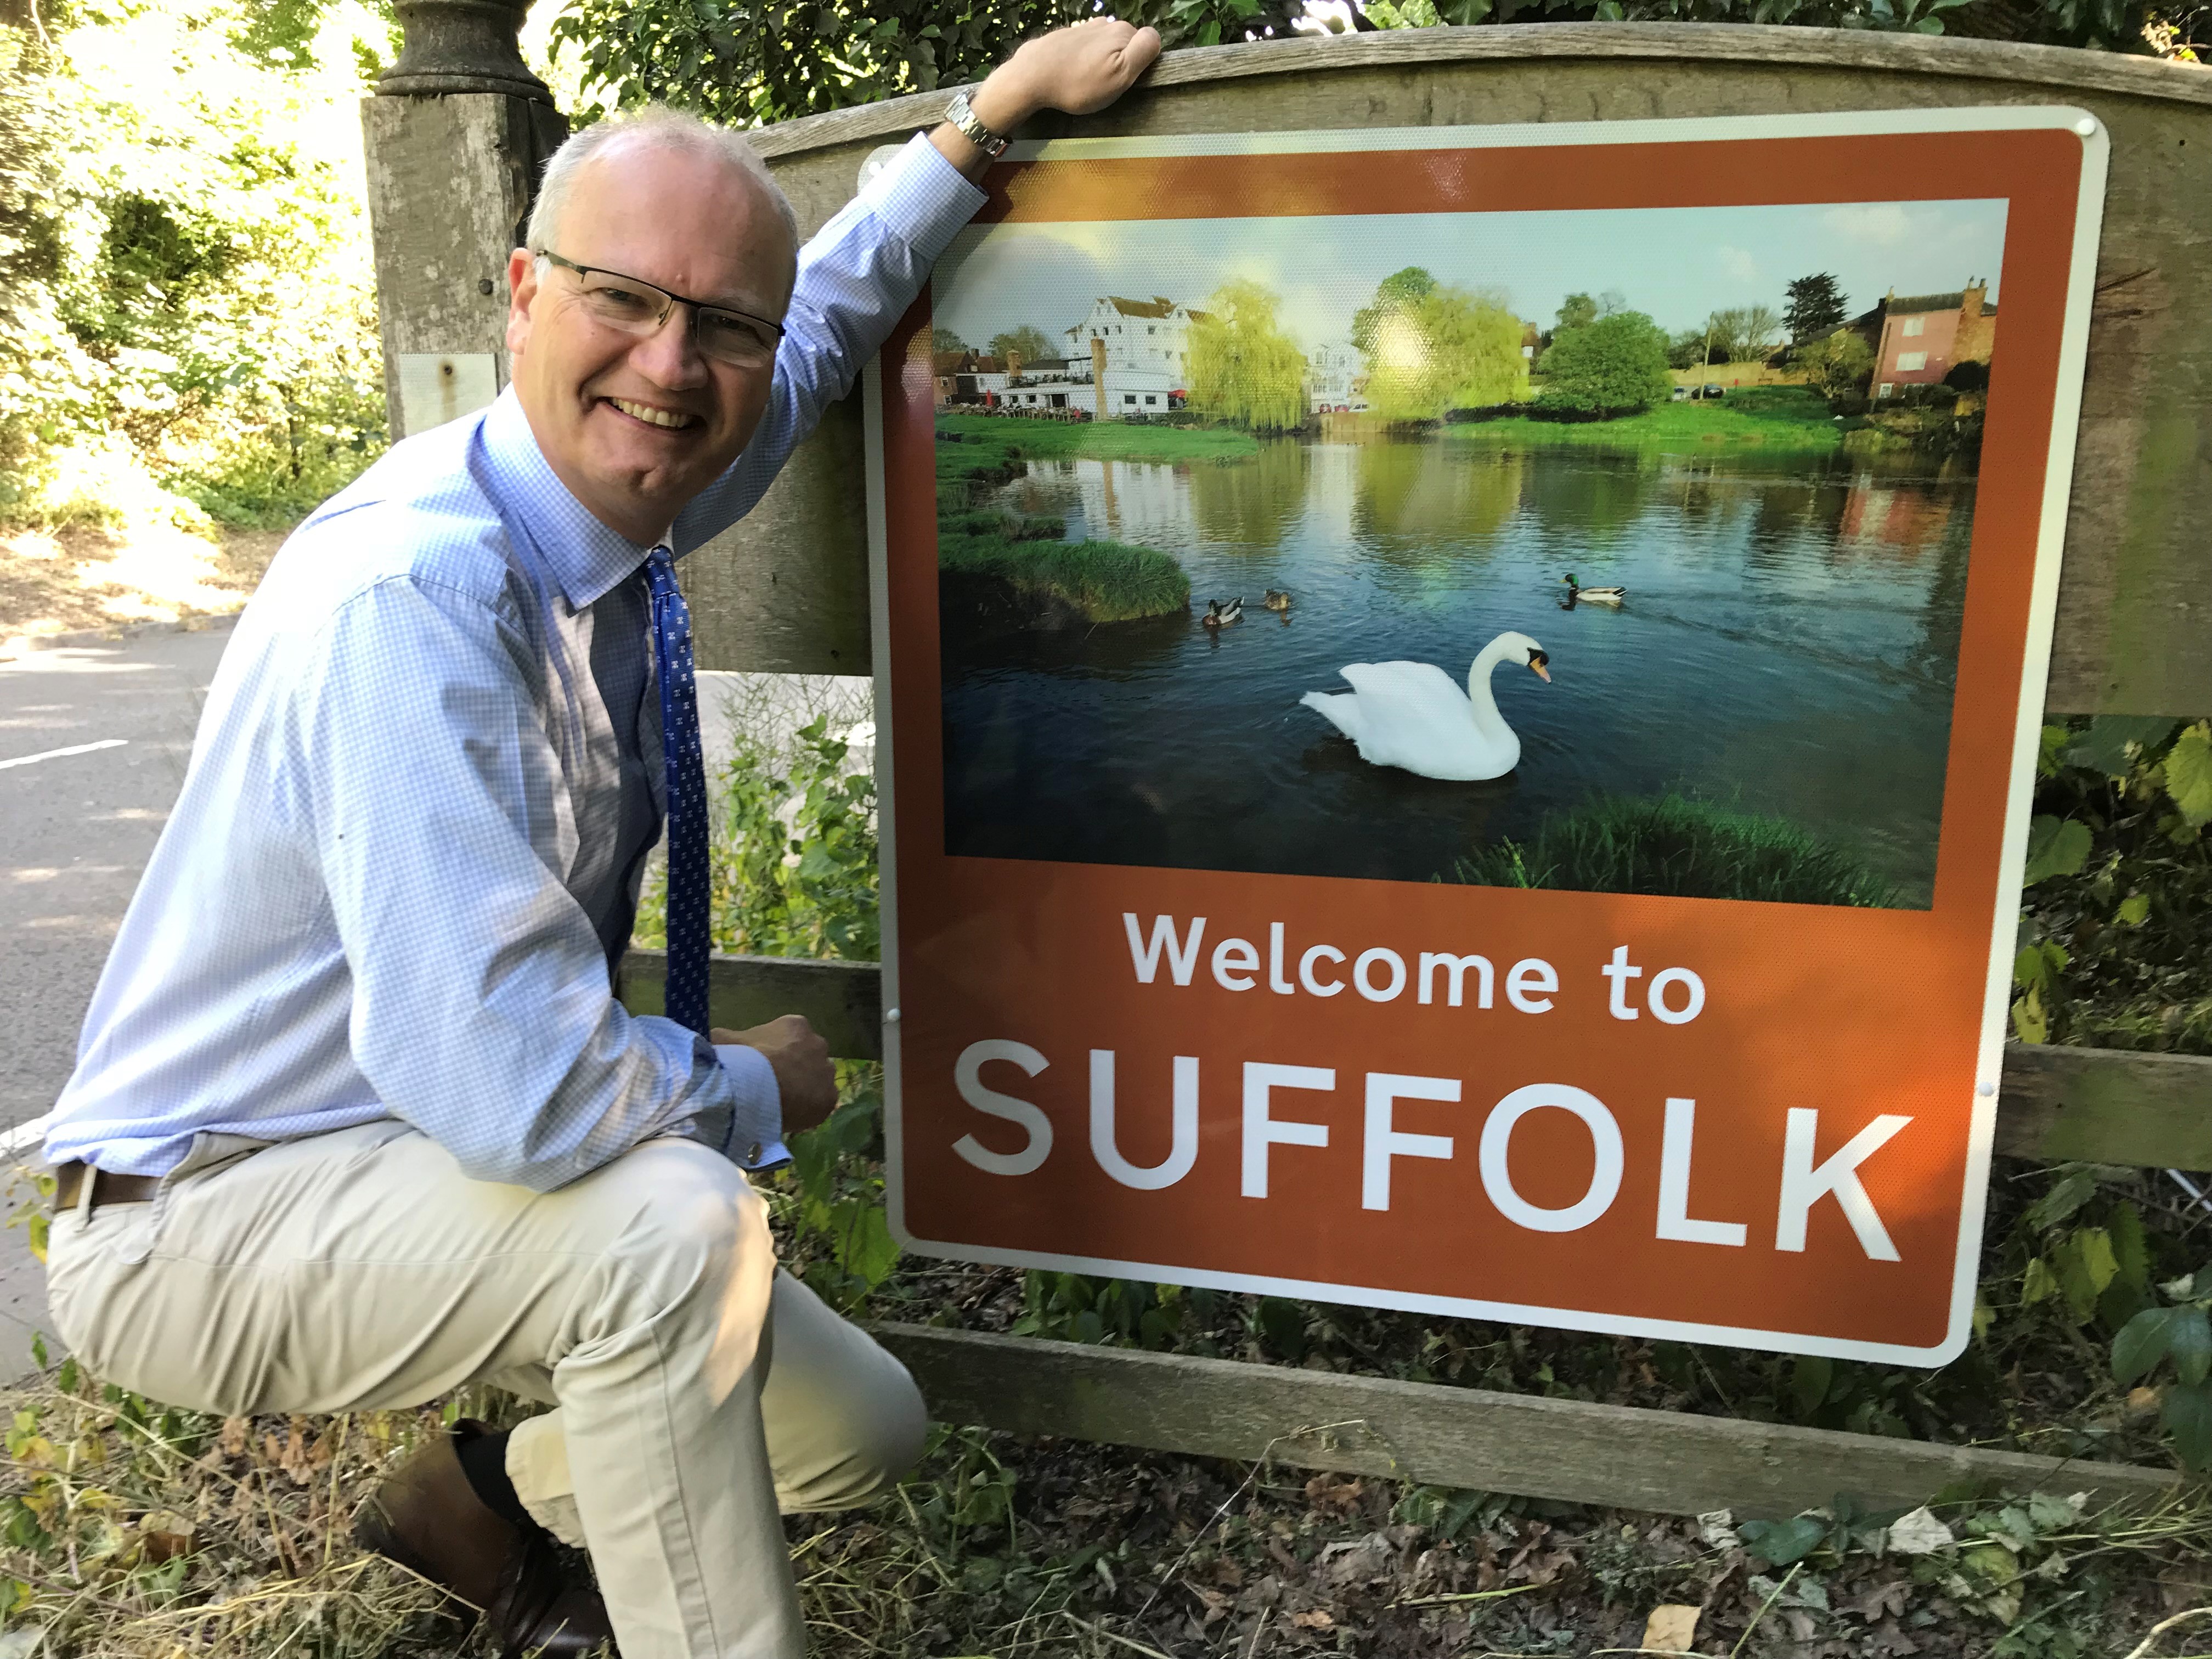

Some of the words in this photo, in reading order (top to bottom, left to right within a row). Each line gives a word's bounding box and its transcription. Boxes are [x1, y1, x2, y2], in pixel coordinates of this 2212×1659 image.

[1123, 912, 1559, 1014] Welcome
[1602, 944, 1706, 1025] to
[951, 1039, 1915, 1262] SUFFOLK
